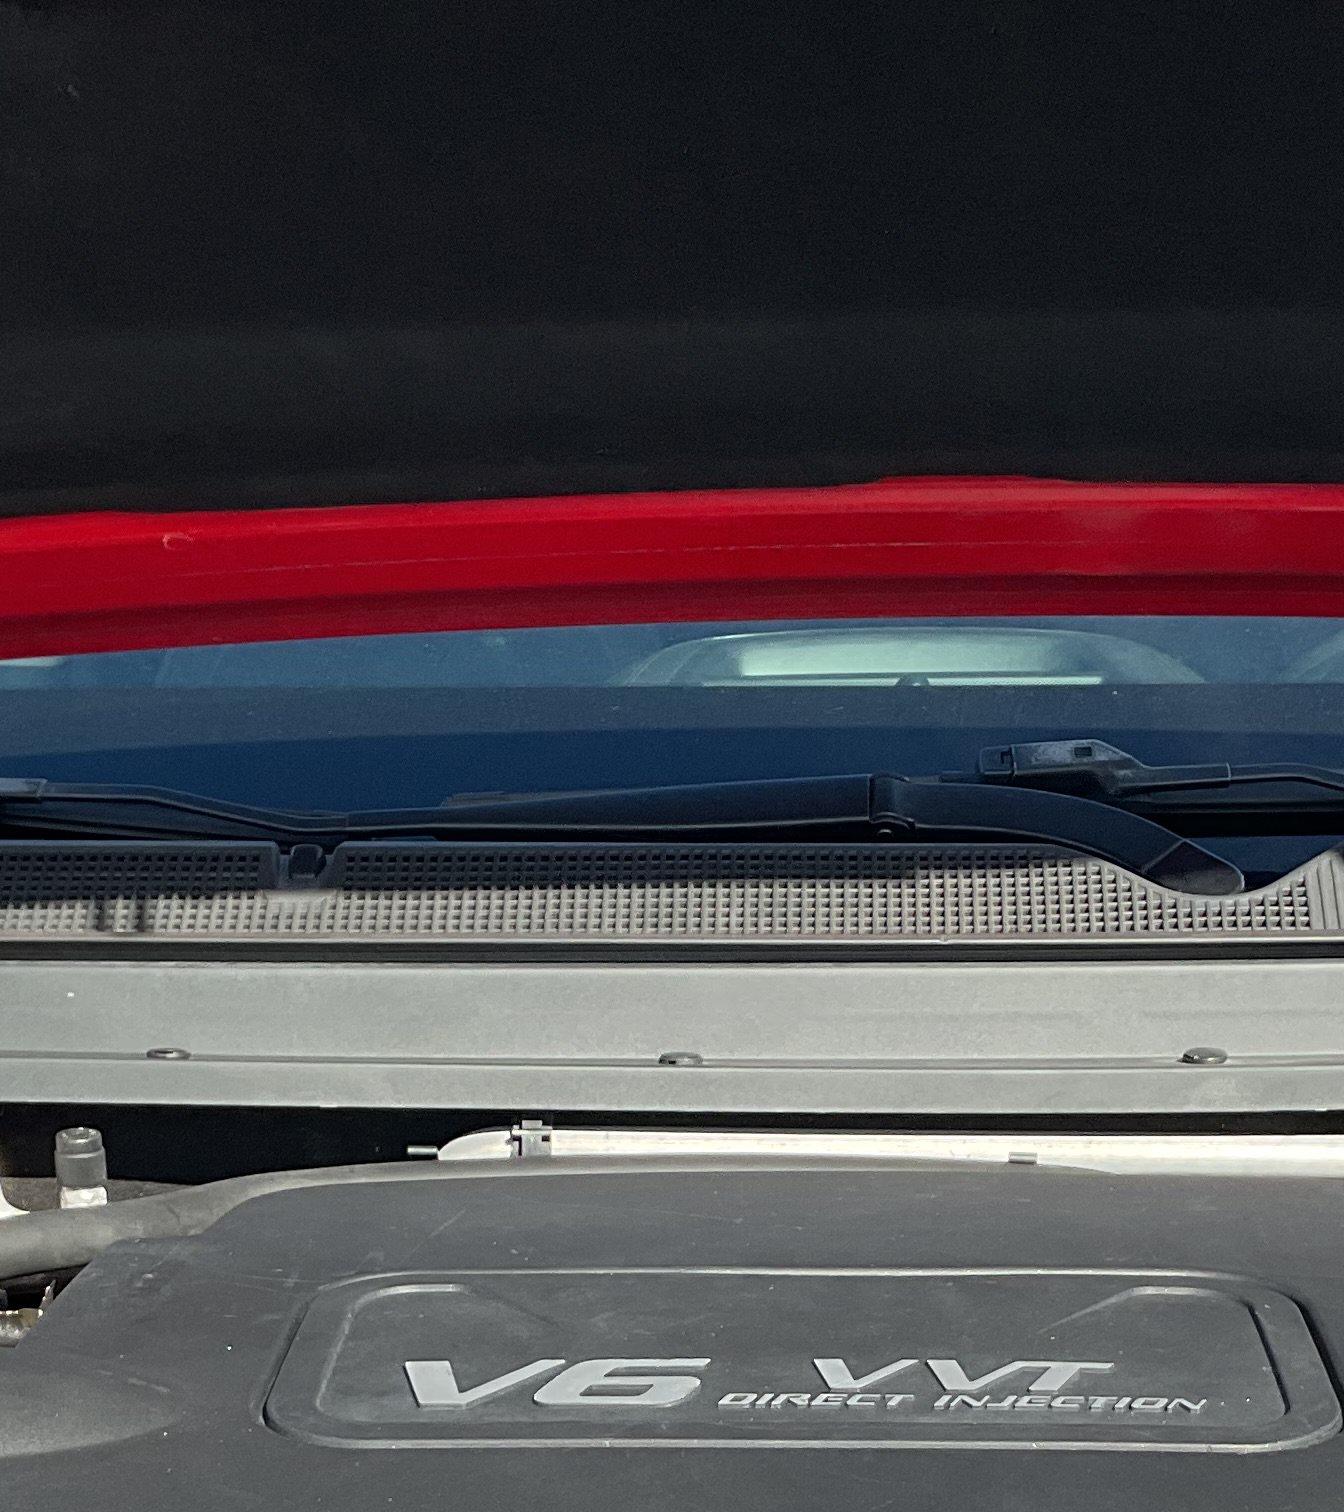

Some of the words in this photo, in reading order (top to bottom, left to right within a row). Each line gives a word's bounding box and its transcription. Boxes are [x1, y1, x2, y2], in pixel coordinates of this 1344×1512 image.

[405, 1358, 712, 1408] V6
[813, 1358, 1114, 1393] VVT
[717, 1393, 915, 1409] DIRECT
[933, 1395, 1207, 1413] INJECTION
